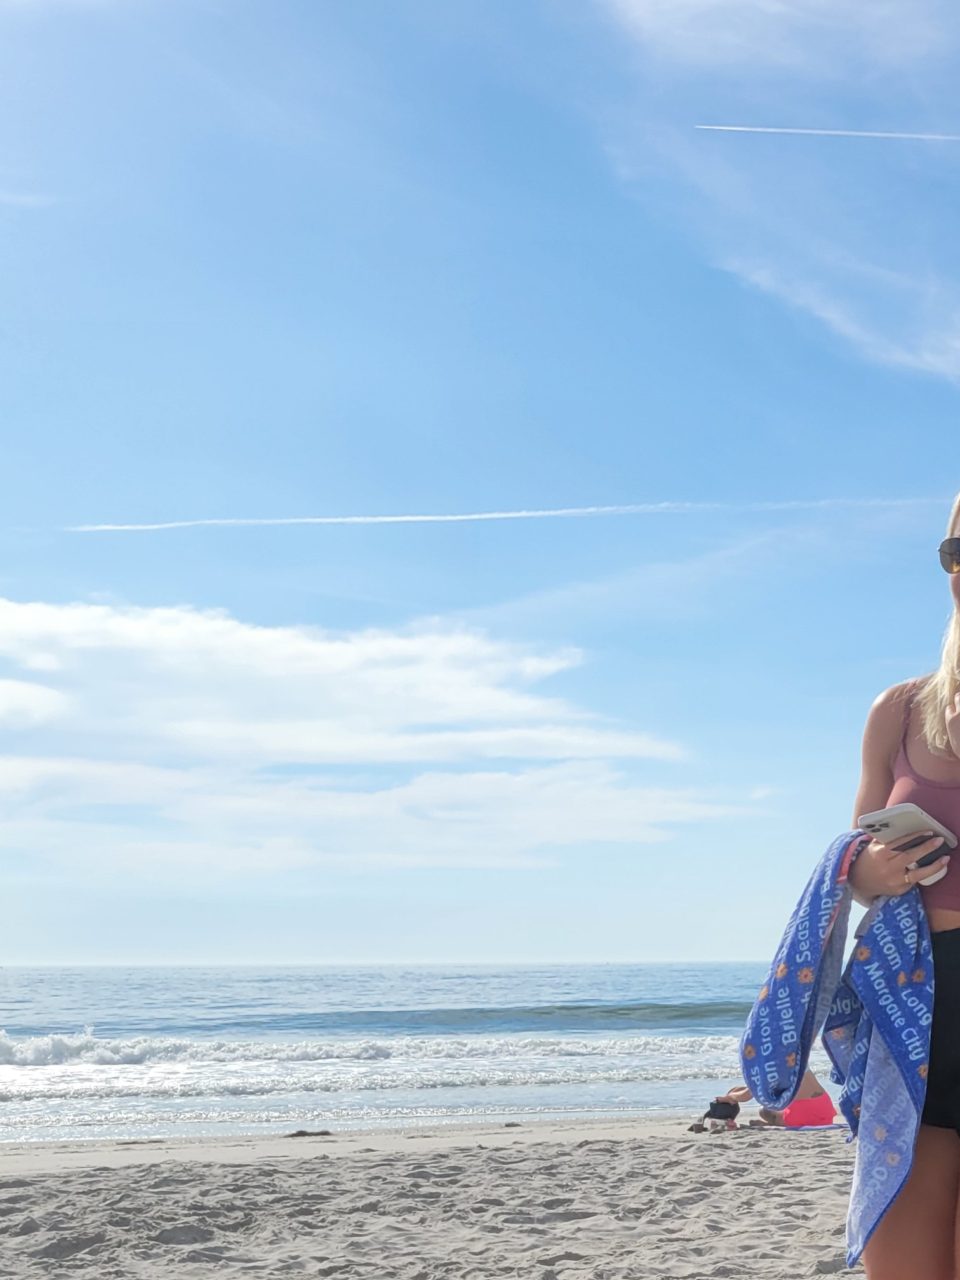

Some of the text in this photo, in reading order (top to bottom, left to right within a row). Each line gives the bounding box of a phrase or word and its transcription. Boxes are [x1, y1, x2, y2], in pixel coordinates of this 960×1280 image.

[759, 1005, 773, 1056] Grove
[776, 986, 797, 1045] Brielle
[864, 962, 906, 1028] Margate
[901, 1028, 926, 1061] City
[901, 988, 932, 1027] Long
